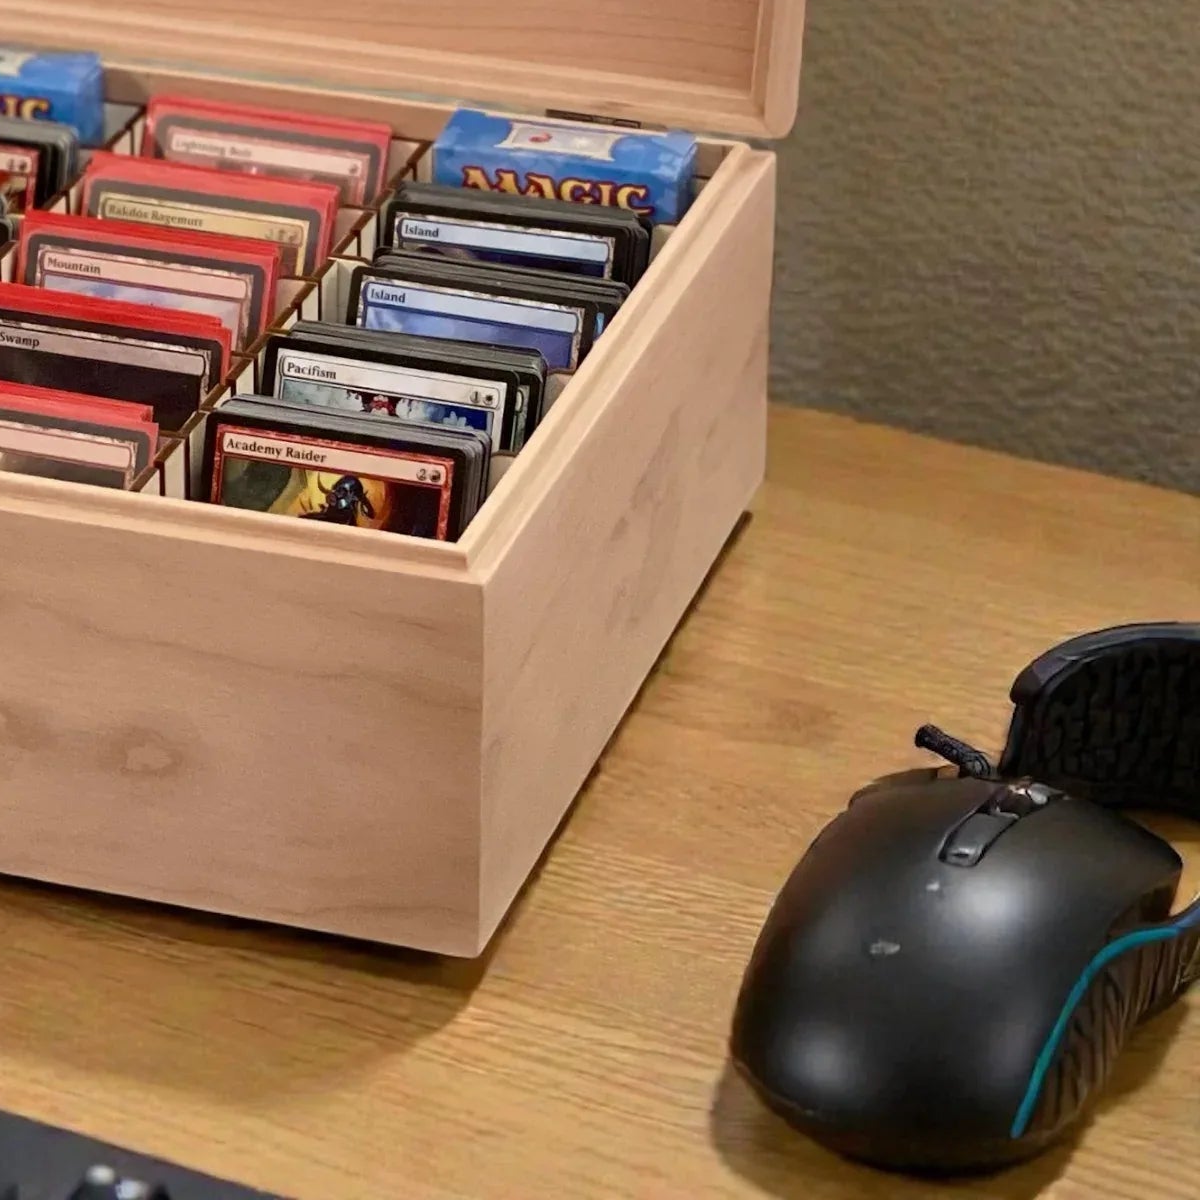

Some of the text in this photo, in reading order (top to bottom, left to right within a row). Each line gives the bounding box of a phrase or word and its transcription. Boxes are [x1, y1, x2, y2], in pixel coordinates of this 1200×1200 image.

[461, 165, 654, 215] MAGIC
[404, 224, 440, 238] Island
[47, 257, 101, 275] Mountain
[370, 288, 406, 304] Island
[0, 331, 40, 348] Swamp
[286, 361, 337, 380] Pacifism
[226, 437, 327, 463] Academy Raider
